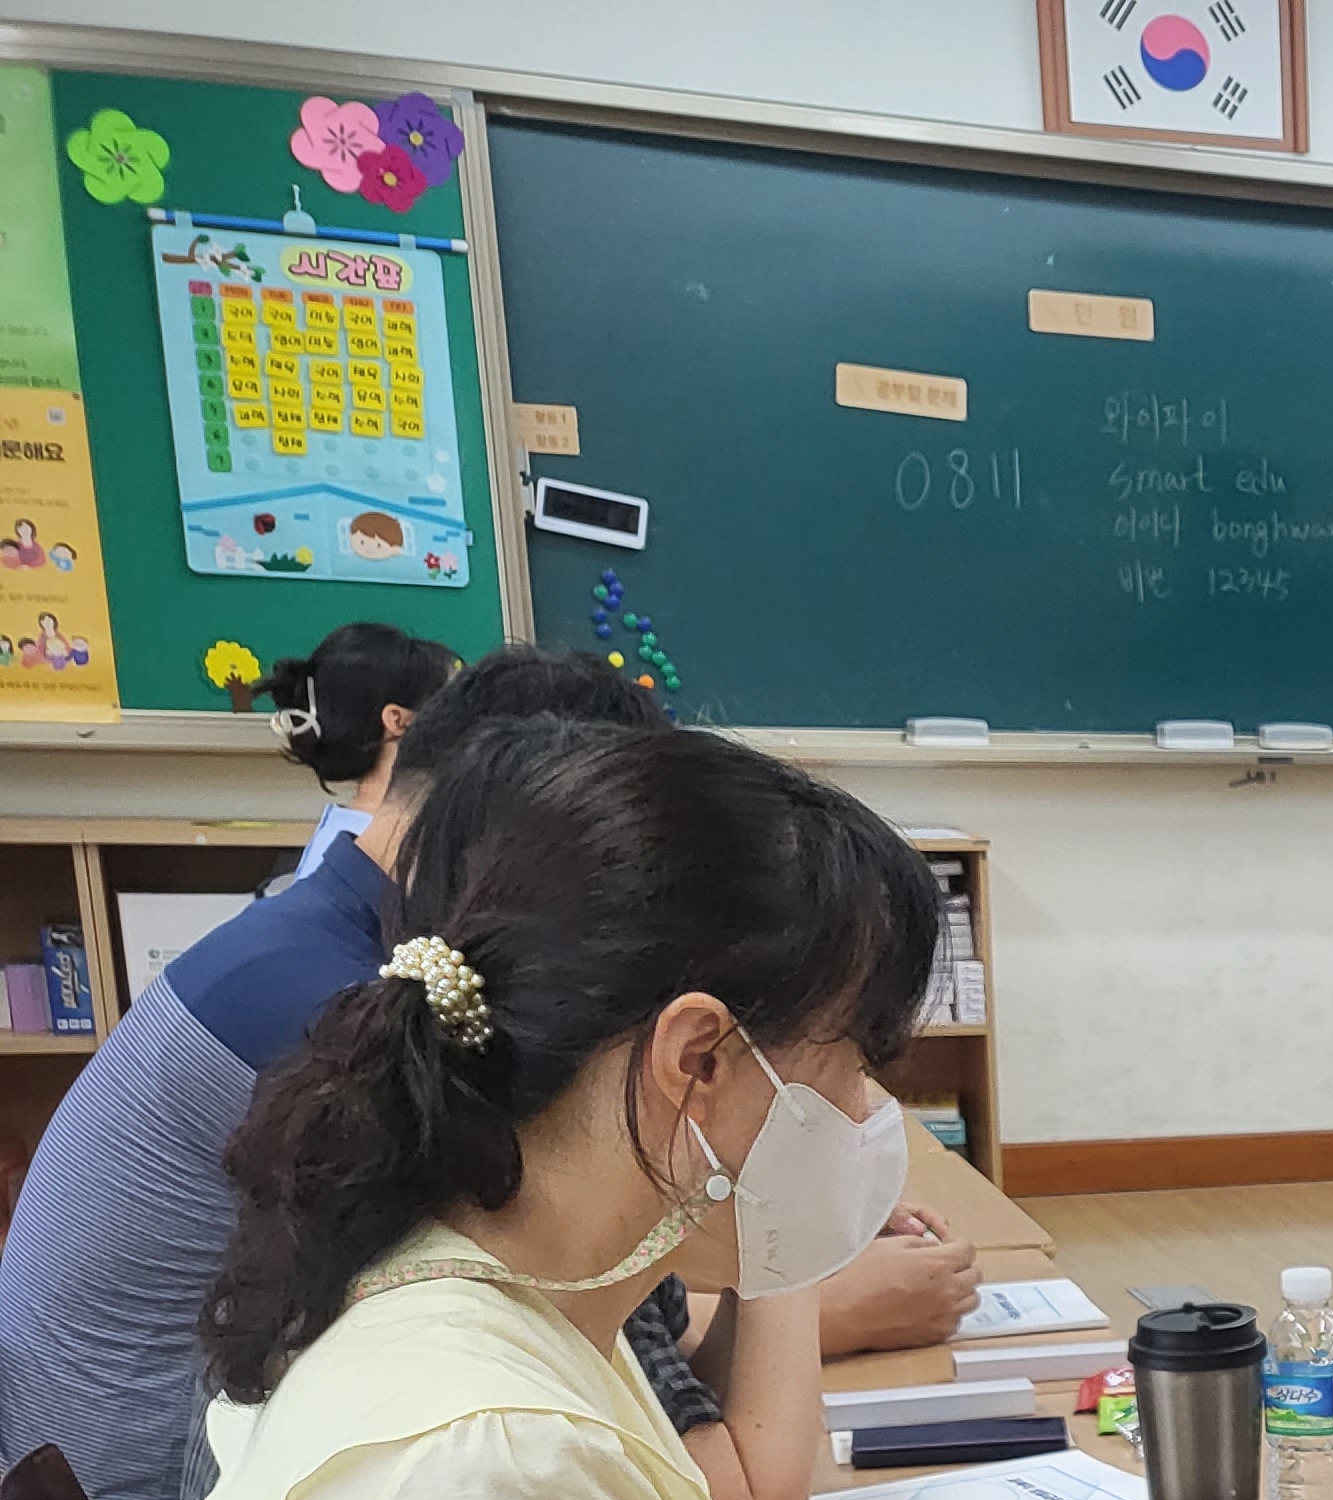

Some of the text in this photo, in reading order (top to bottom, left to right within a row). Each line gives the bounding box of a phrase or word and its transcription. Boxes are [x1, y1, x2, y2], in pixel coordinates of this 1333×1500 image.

[288, 250, 402, 290] 시간표
[1099, 392, 1228, 446] 와이파이
[0, 439, 66, 463] 문해요
[893, 446, 1024, 512] 0811
[1112, 504, 1182, 546] 아이디
[1208, 564, 1292, 602] 12345
